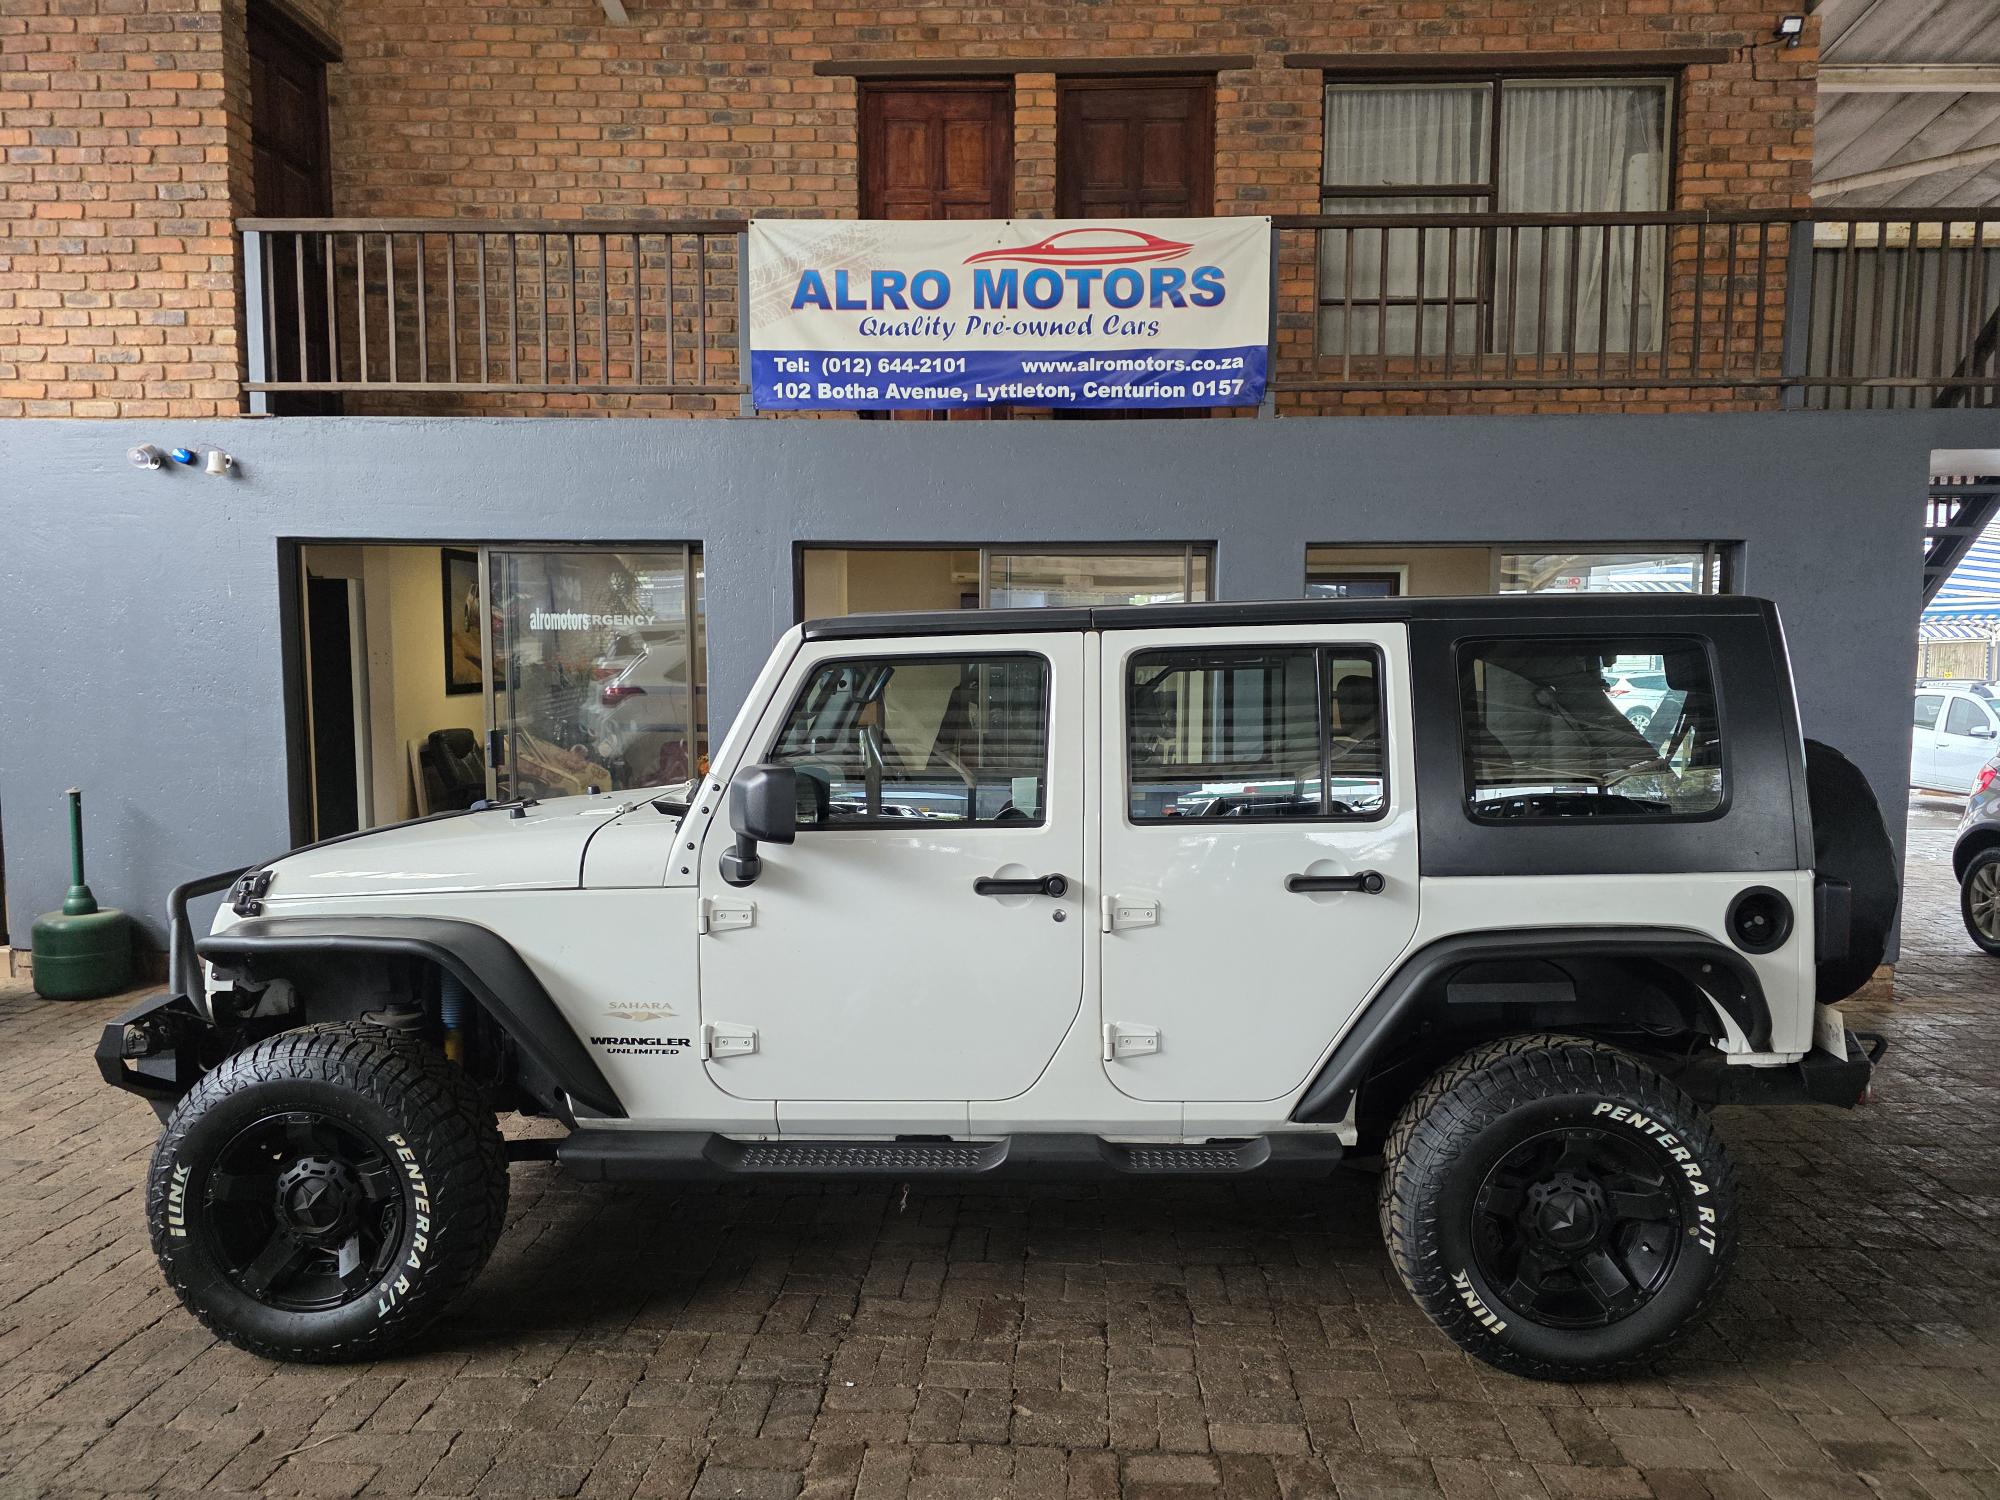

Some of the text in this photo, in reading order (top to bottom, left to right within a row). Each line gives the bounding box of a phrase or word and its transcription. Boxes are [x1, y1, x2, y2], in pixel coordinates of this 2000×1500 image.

[790, 266, 1226, 311] ALRO MOTORS
[859, 314, 1160, 341] Quality Pre-owned Cars
[773, 356, 1244, 376] Tel: (012) 644-2101 www.alromotors.co.za
[773, 379, 1244, 402] 102 Botha Avenue, Lyttleton, Centurion 0157
[529, 608, 588, 630] alromotors
[609, 1001, 673, 1009] SAHARA
[590, 1036, 691, 1048] WRANGLER
[1591, 1101, 1710, 1196] PENTERRA
[386, 1132, 430, 1270] PENTERRA
